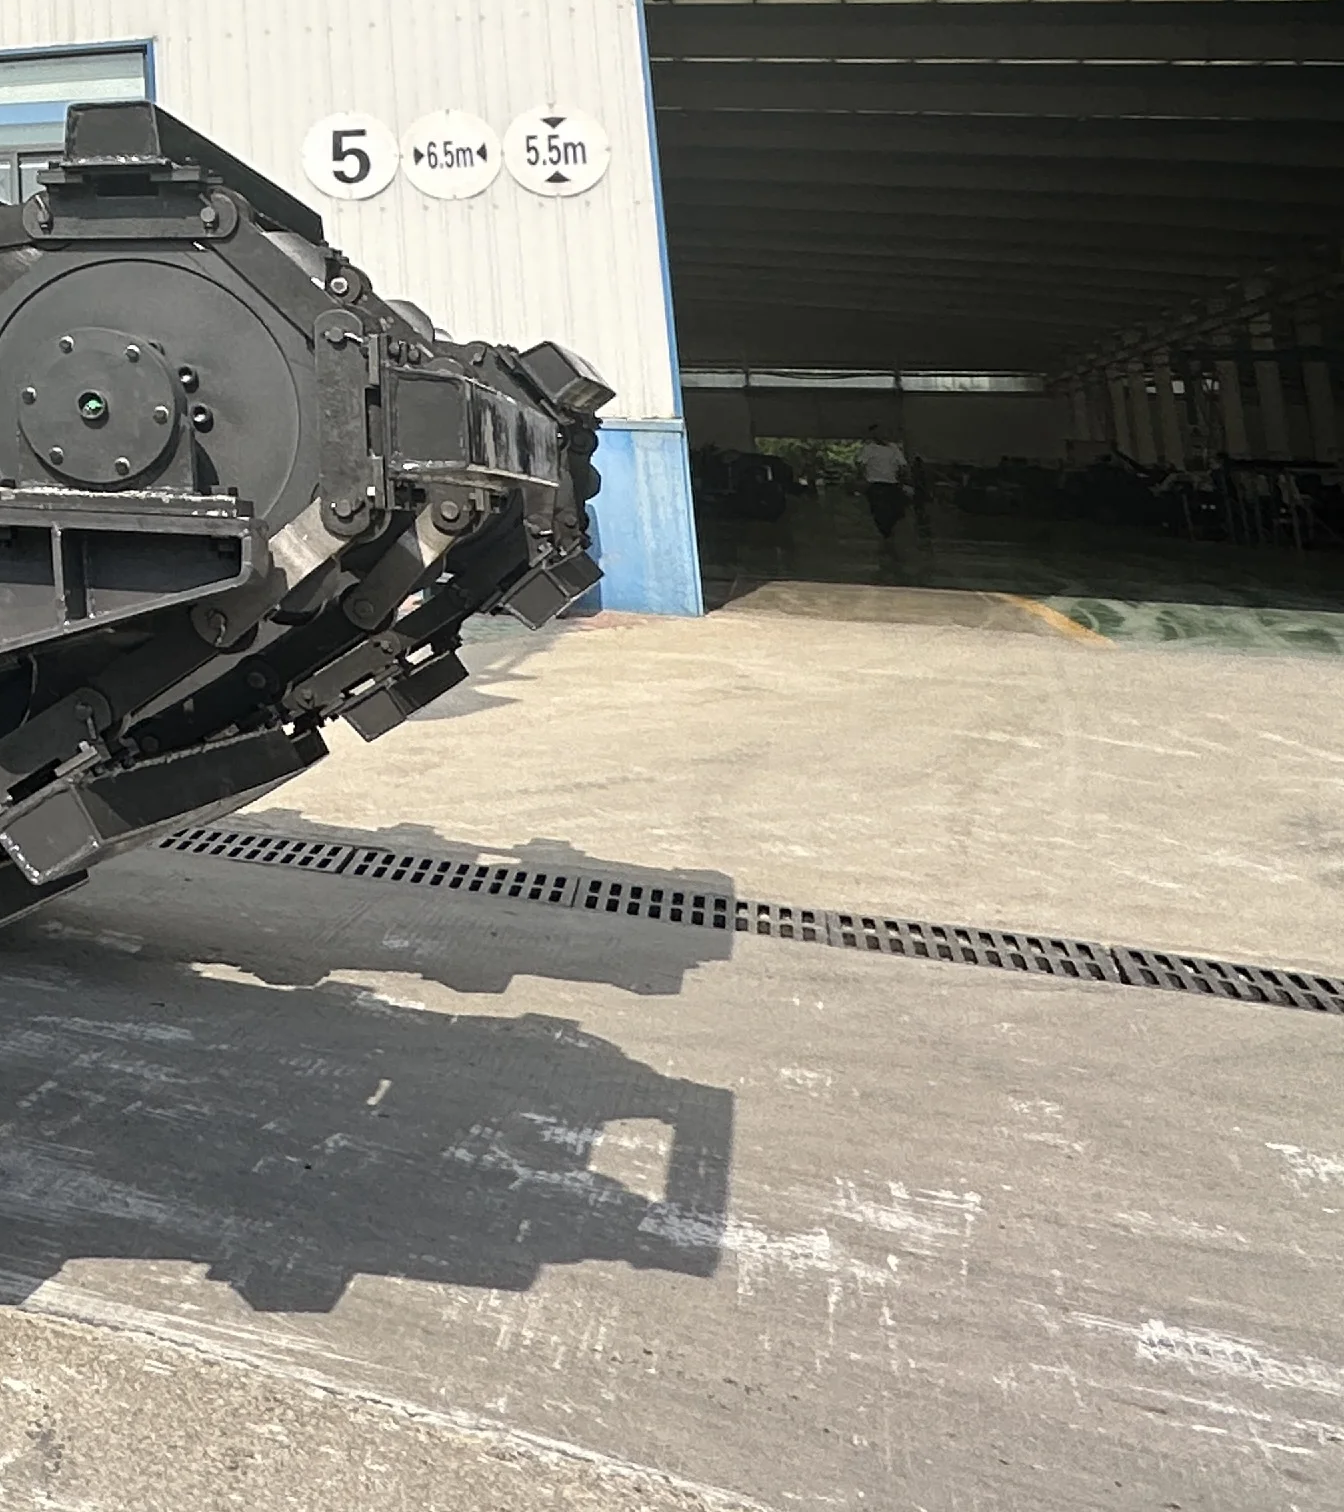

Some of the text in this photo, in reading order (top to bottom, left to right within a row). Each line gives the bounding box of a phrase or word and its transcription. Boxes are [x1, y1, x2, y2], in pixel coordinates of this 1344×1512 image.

[332, 128, 371, 184] 5
[426, 141, 475, 169] 6.5m
[525, 134, 588, 166] 5.5m
